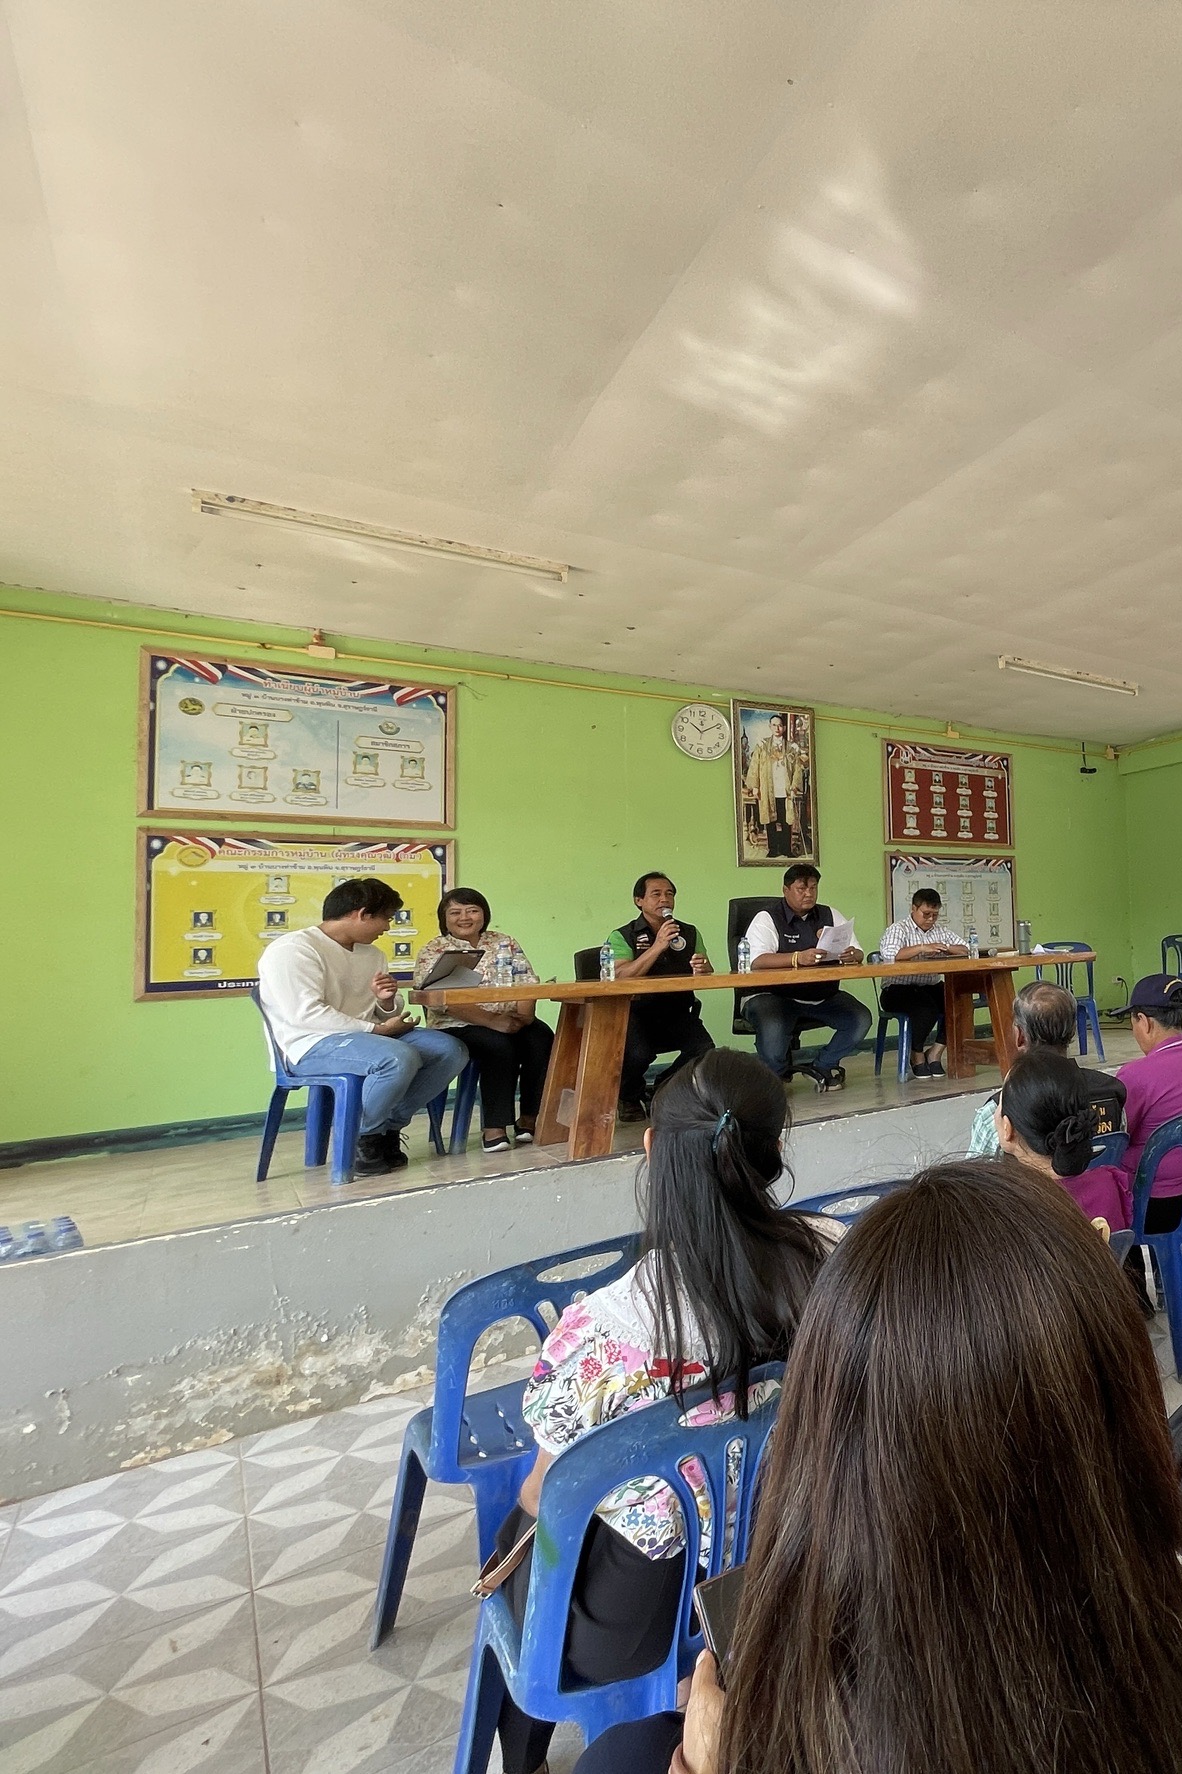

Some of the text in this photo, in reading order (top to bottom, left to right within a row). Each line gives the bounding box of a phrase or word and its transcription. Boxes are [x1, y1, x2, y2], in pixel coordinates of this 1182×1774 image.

[218, 848, 327, 860] คณะกรรมการหมู่บ้าน
